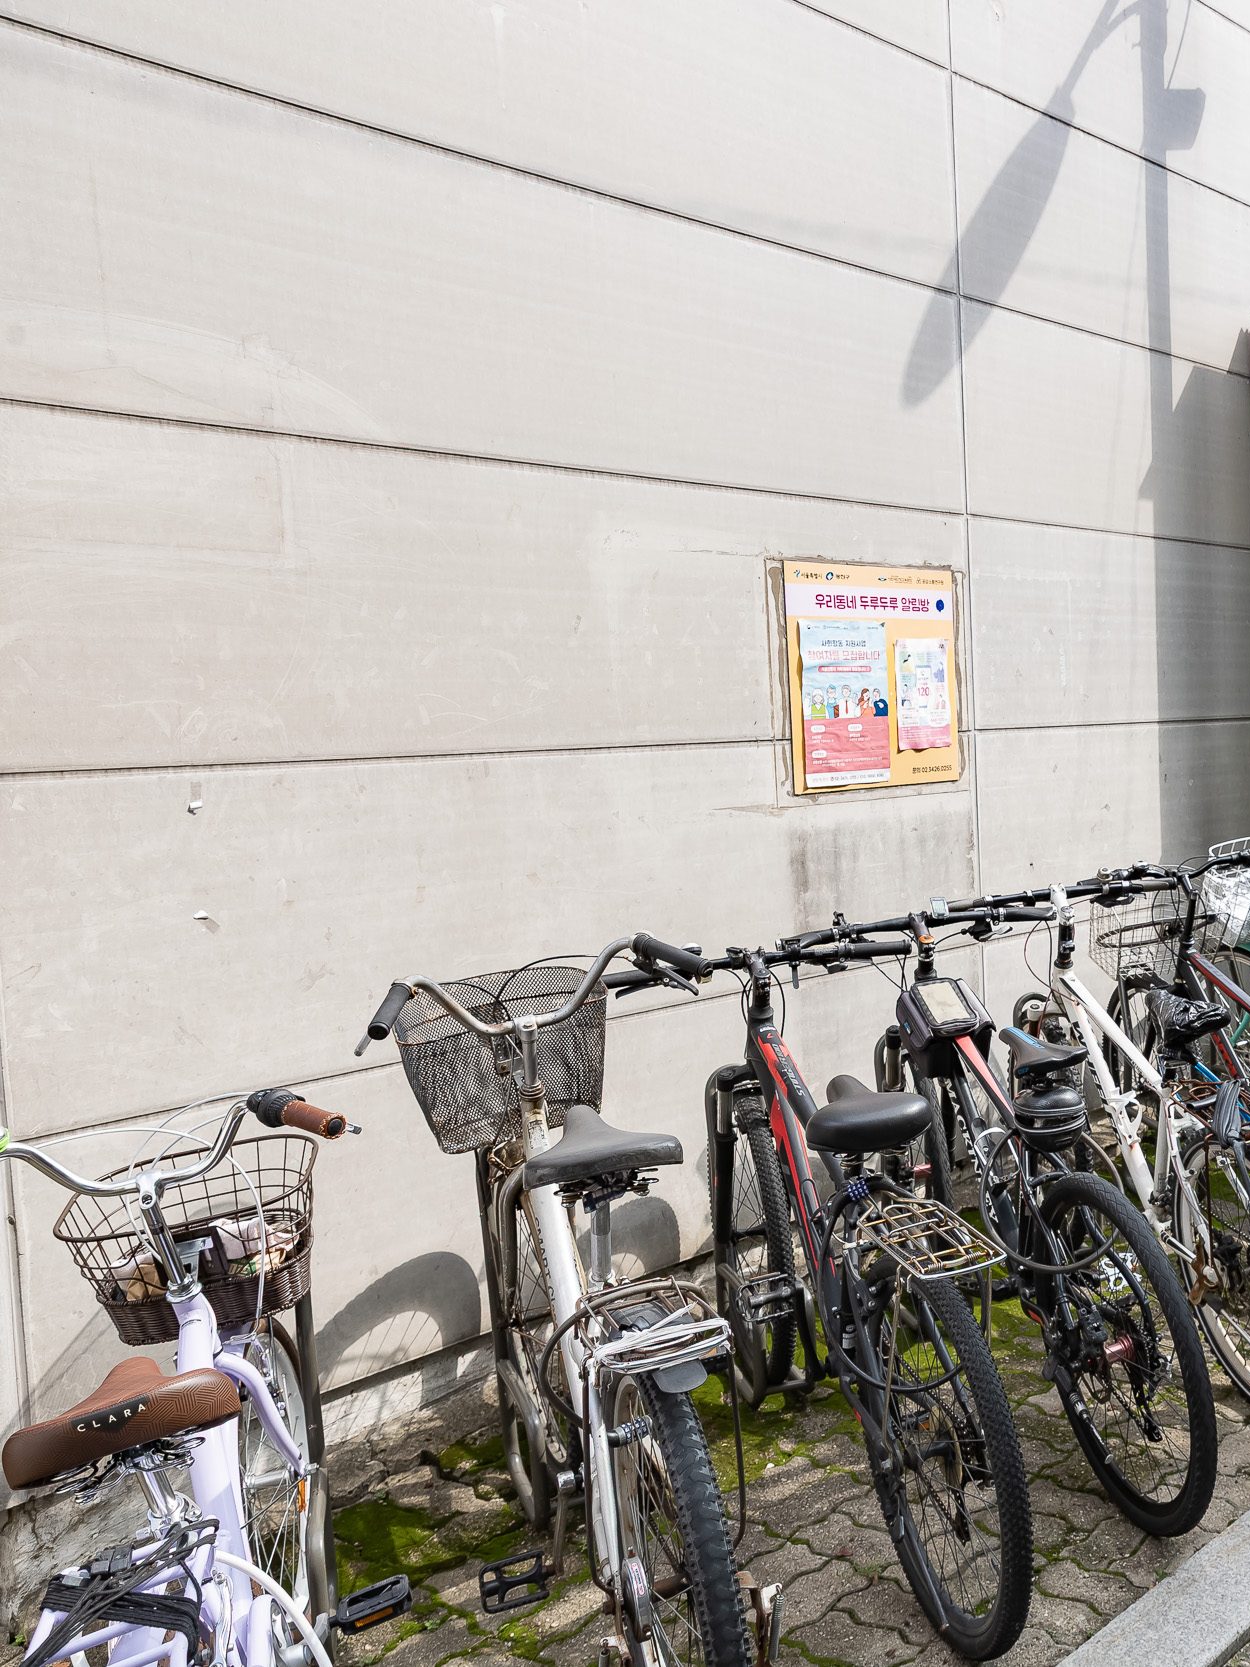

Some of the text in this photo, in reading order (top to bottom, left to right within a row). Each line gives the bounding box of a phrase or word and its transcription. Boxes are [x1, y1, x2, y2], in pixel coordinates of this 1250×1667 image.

[815, 594, 930, 612] 우리동네 두루두루 알림방
[807, 650, 880, 661] 참여자를 모집합니다
[918, 687, 930, 697] 120
[77, 1403, 146, 1432] CLARA
